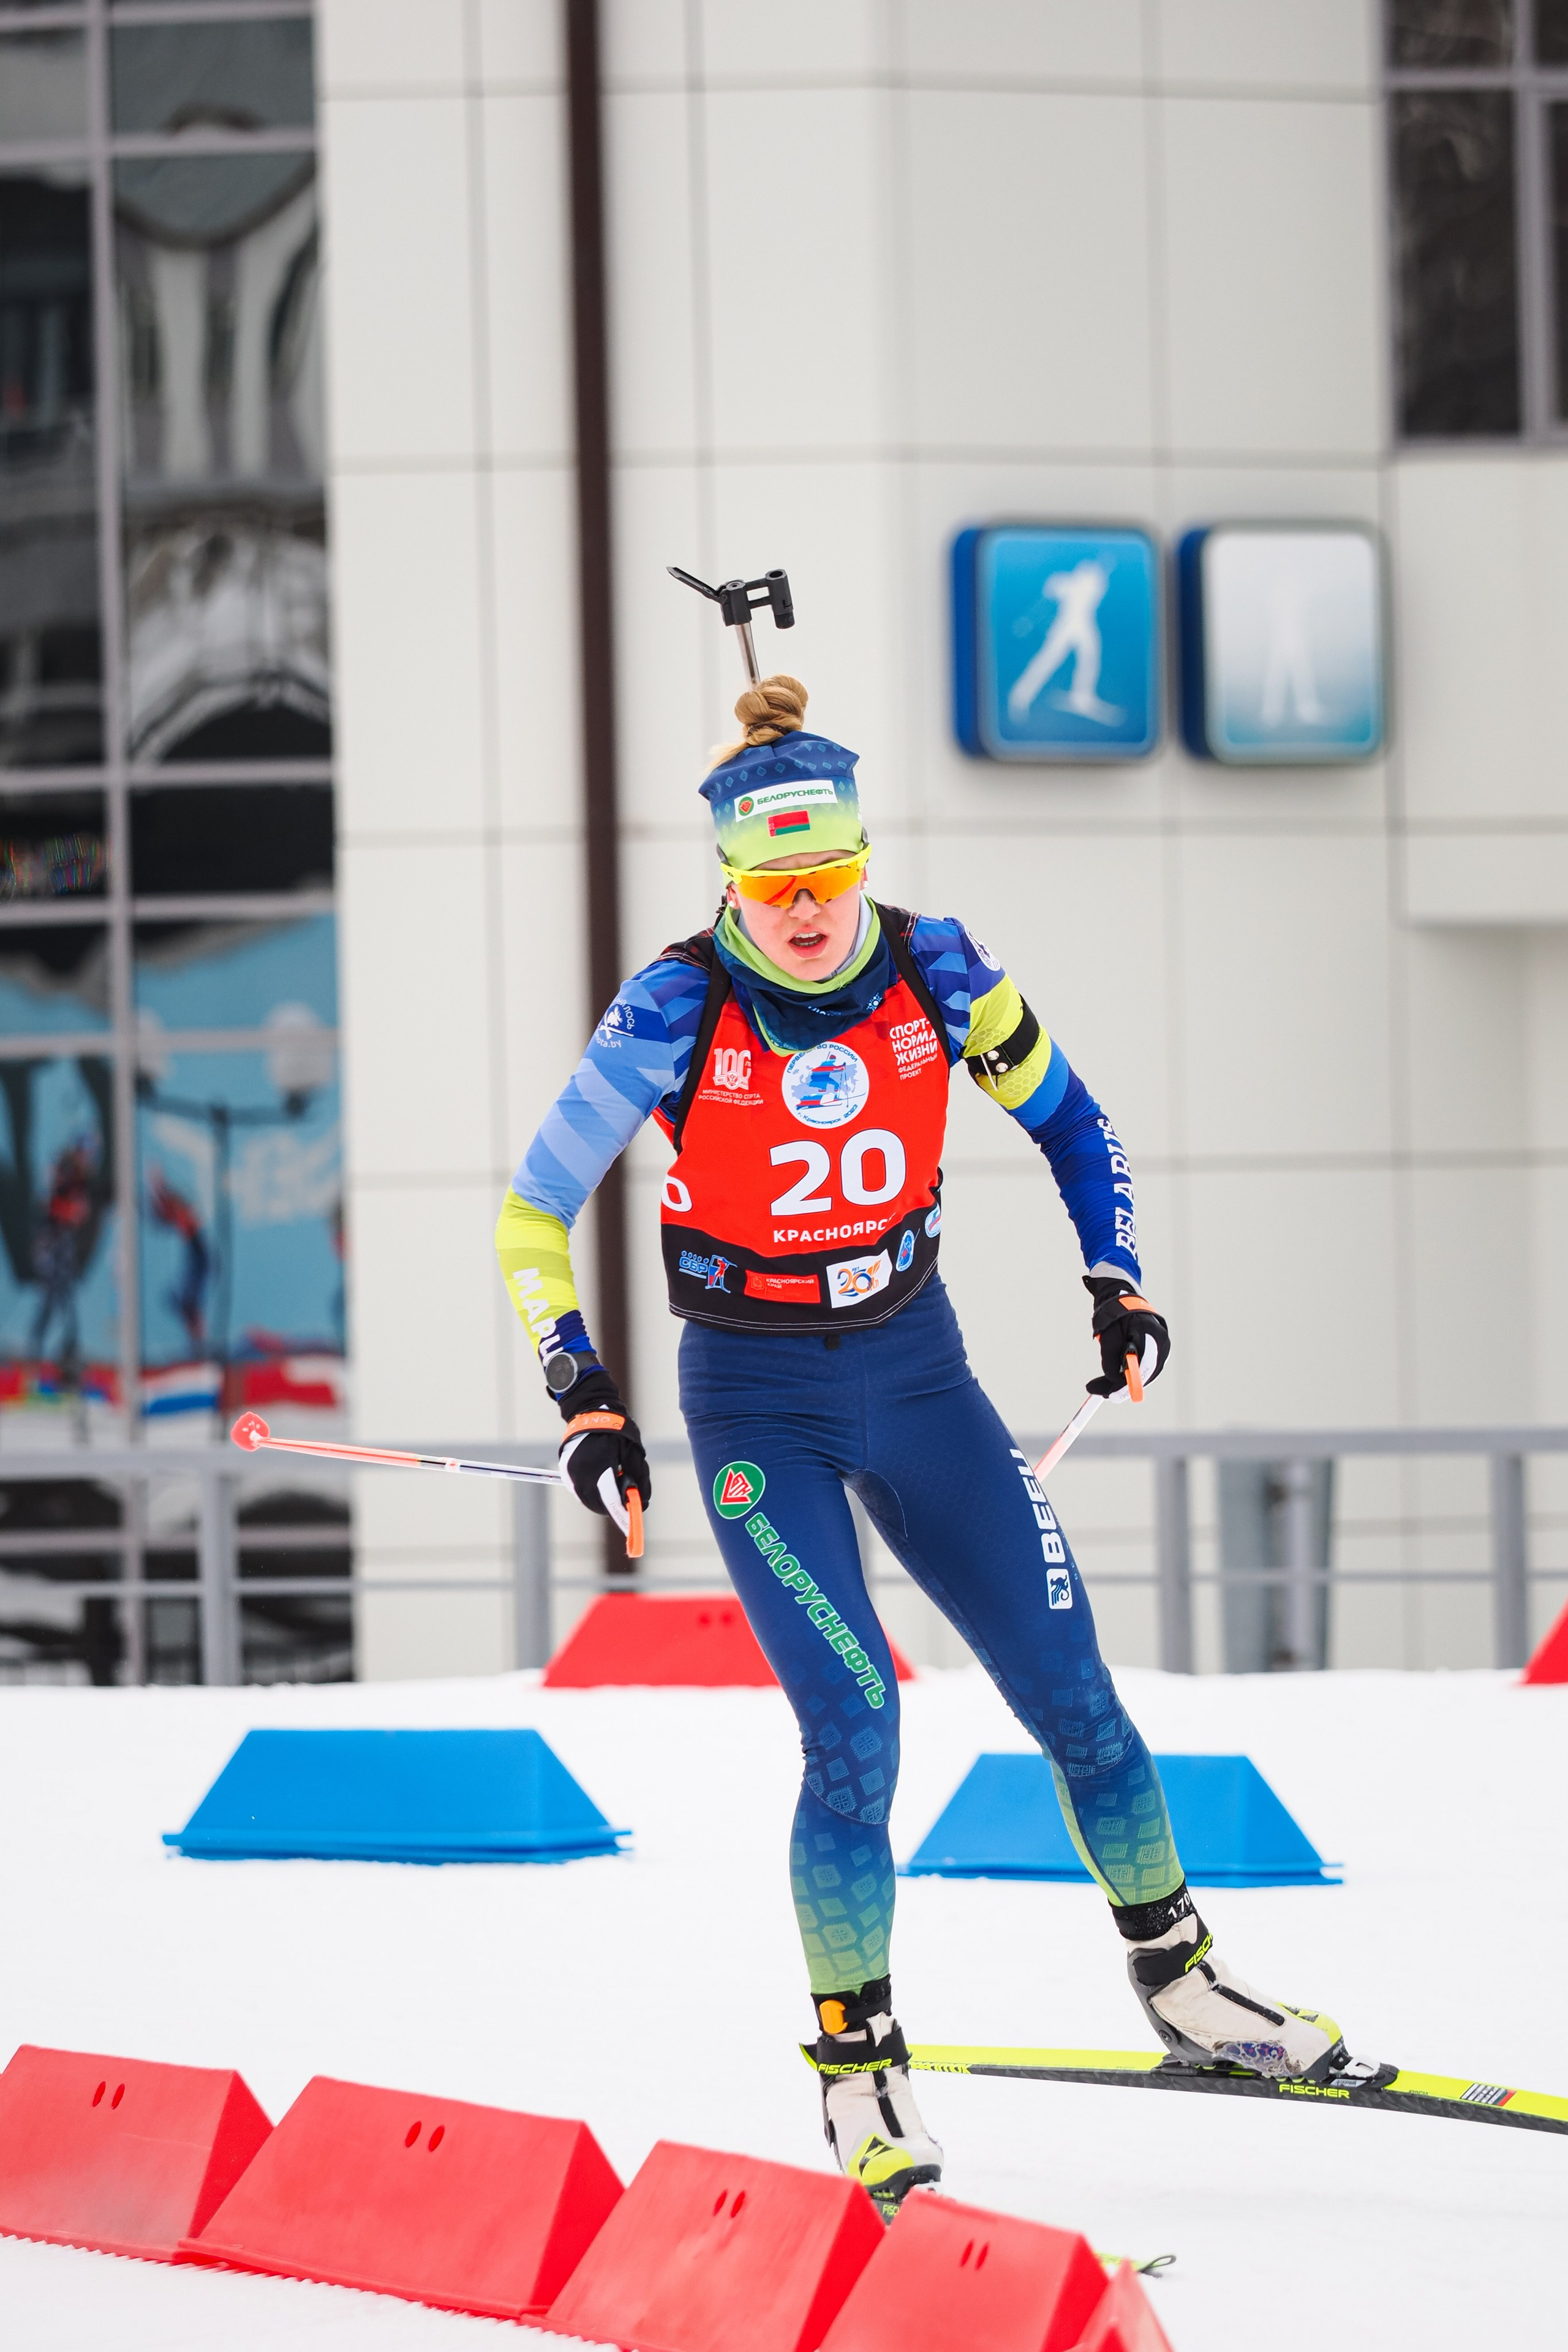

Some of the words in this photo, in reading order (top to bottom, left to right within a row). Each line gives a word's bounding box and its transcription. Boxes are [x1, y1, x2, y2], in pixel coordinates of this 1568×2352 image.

[757, 789, 833, 805] БЕЛОРУСНЕФТЬ
[889, 1017, 930, 1039] СПОРТ-
[892, 1028, 937, 1053] НОРМА
[829, 1044, 858, 1062] РОССИИ
[895, 1040, 938, 1066] ЖИЗНИ
[900, 1068, 922, 1080] ПРОЕКТ
[698, 1095, 733, 1104] РОССИЙСКОЙ
[702, 1089, 743, 1099] МИНИСТЕРСТВО
[769, 1128, 907, 1216] 20
[774, 1213, 897, 1242] КРАСНОЯРС
[679, 1257, 707, 1273] СБР
[745, 1512, 886, 1709] БЕЛОРУСНЕФТЬ
[817, 2057, 893, 2074] FISCHER
[1279, 2084, 1350, 2099] FISCHER
[882, 2204, 900, 2216] FISC
